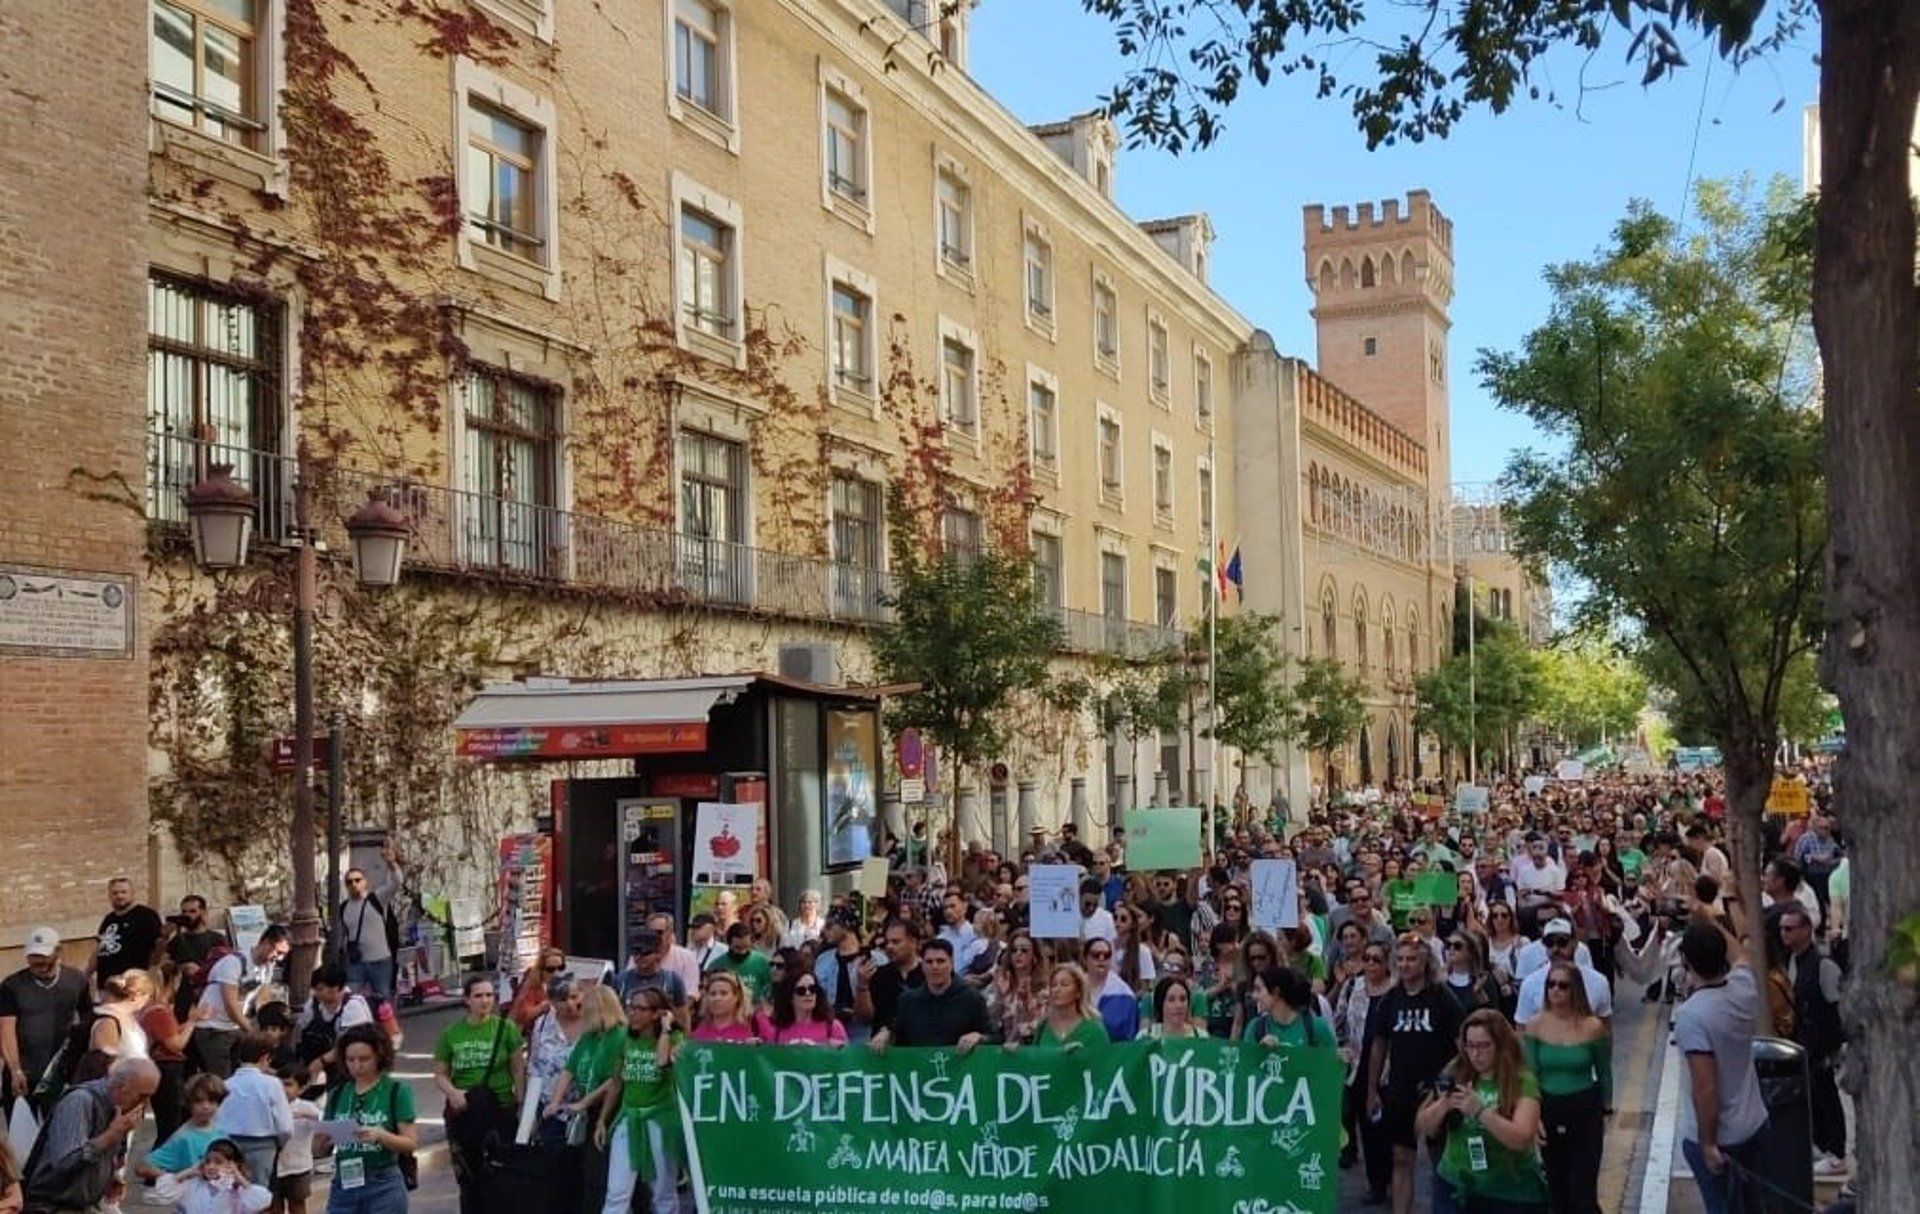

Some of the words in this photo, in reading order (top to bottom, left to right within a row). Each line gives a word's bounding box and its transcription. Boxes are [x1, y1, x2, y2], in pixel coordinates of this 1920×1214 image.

[692, 1069, 748, 1123] EN
[774, 1069, 979, 1126] DEFENSA
[997, 1072, 1067, 1125] DE
[1083, 1065, 1137, 1120] LA
[1149, 1049, 1316, 1126] PÚBLICA
[865, 1137, 950, 1175] MAREA
[957, 1141, 1039, 1180] VERDE
[718, 1185, 747, 1200] una
[749, 1185, 811, 1202] escuela
[815, 1185, 877, 1207] pública
[880, 1187, 900, 1206] de
[961, 1193, 997, 1211] para
[999, 1192, 1050, 1212] tod@s
